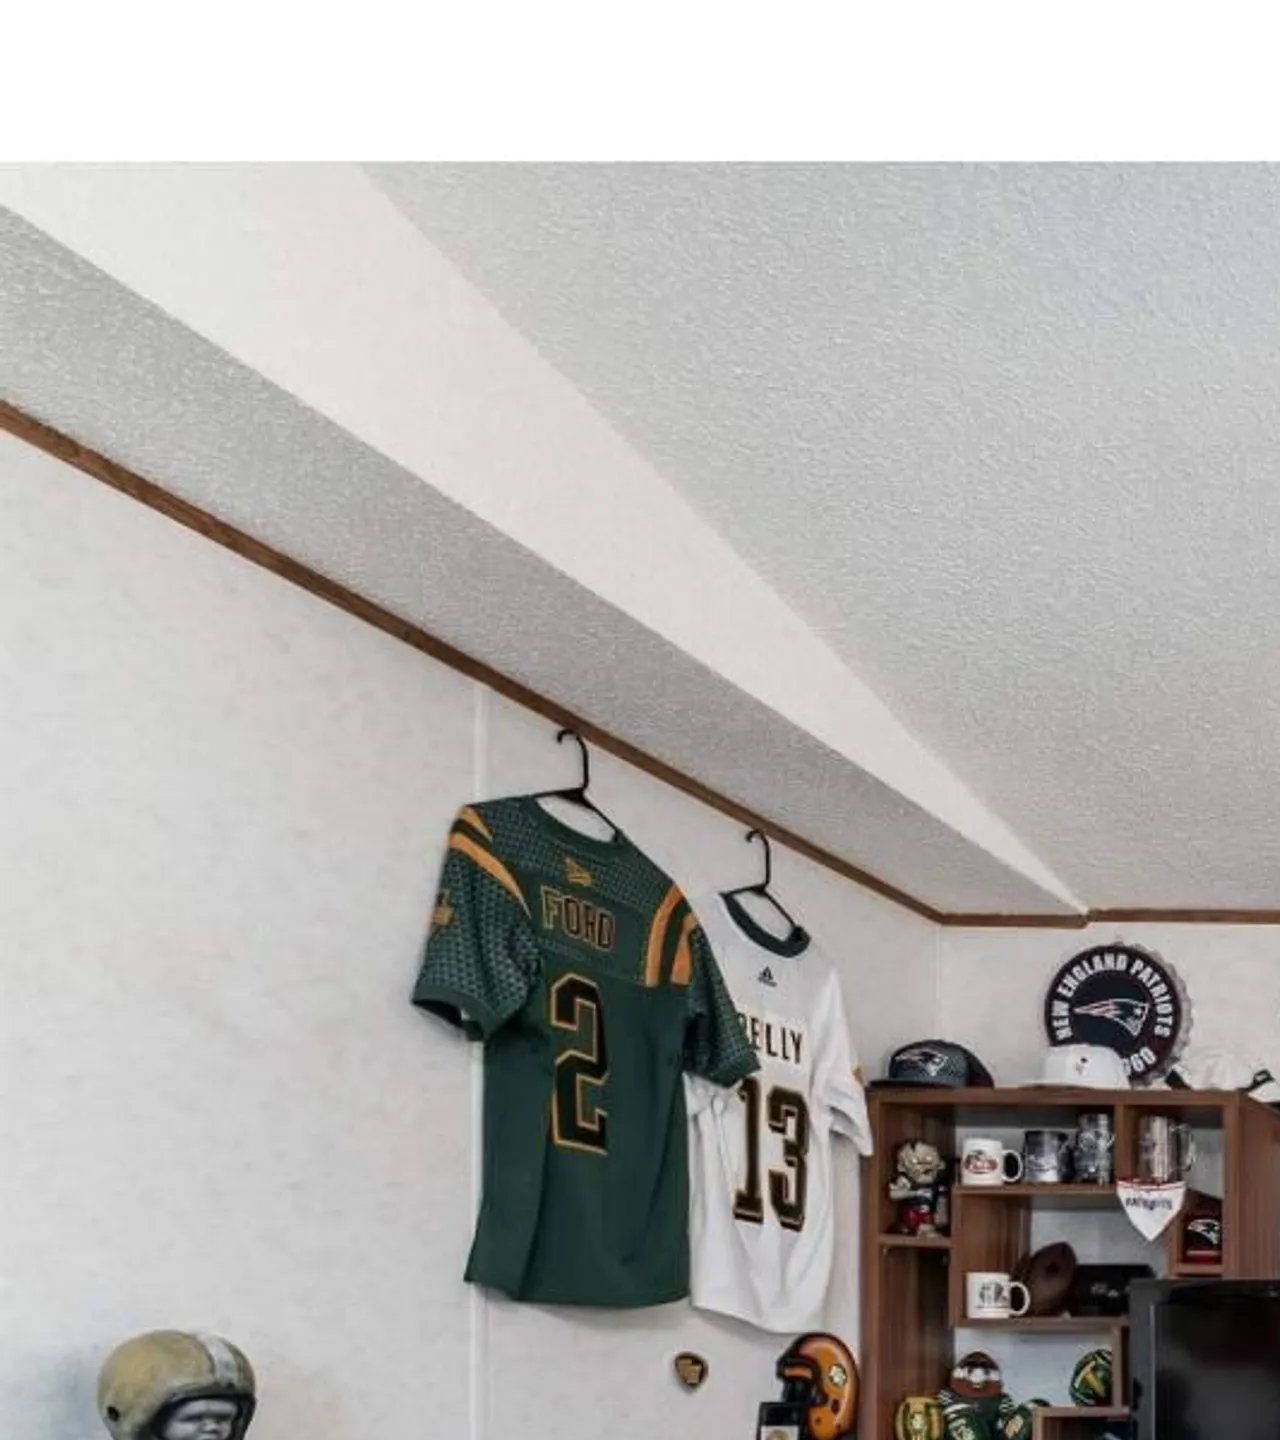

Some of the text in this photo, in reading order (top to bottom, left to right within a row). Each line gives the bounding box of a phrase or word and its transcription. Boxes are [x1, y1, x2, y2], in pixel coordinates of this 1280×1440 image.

[539, 884, 615, 952] FORD
[1051, 952, 1174, 1041] NEW ENGLAND PATRIOTS
[549, 971, 610, 1156] 2
[733, 1076, 811, 1233] 13
